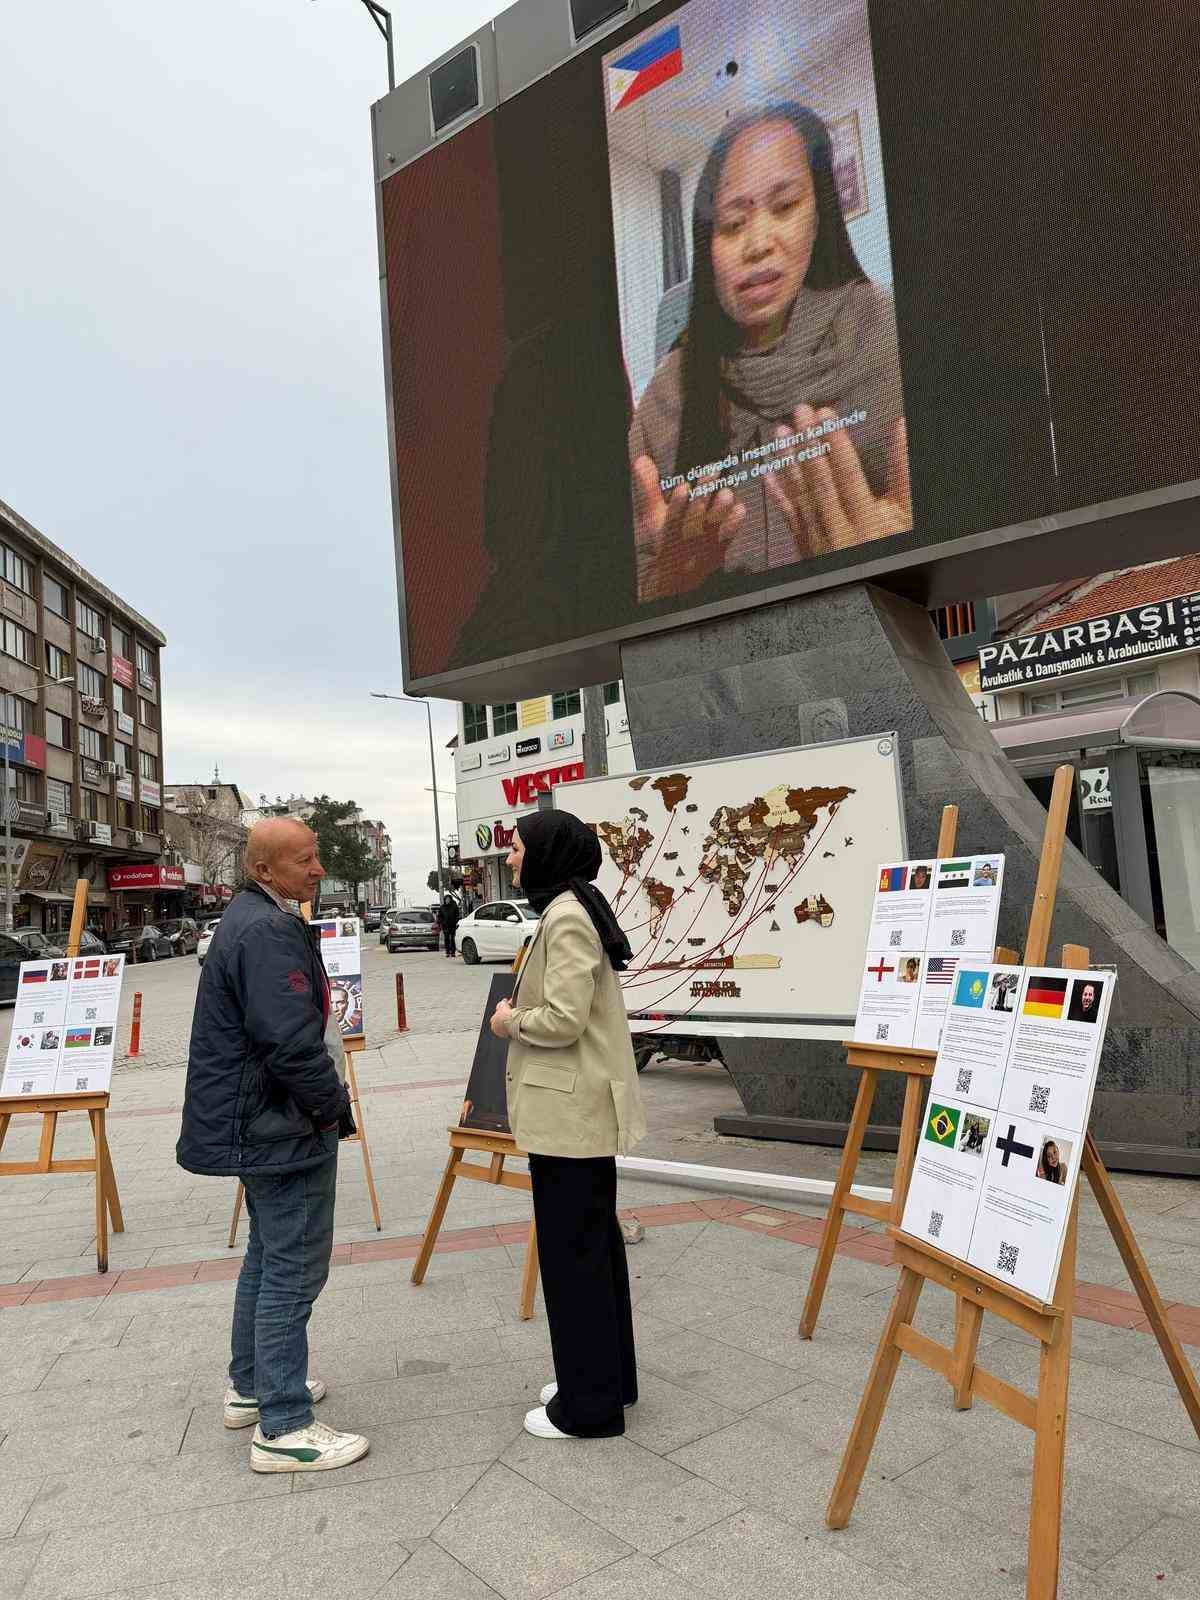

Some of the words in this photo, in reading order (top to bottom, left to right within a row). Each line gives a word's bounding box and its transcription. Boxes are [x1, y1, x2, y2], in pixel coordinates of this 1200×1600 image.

[660, 474, 684, 491] tüm
[687, 454, 739, 482] dünyada
[741, 431, 804, 463] insanların
[807, 409, 867, 439] kalbinde
[689, 471, 748, 503] yaşamaya
[750, 455, 795, 478] devam
[798, 442, 832, 462] etsin
[978, 601, 1176, 670] PAZARBAŞI
[981, 665, 1024, 689] Avukatlık
[1025, 666, 1034, 679] &
[1035, 653, 1095, 678] Danışmanlık
[1096, 649, 1106, 662] &
[1107, 632, 1180, 662] Arabuluculuk
[122, 873, 153, 881] vodafone
